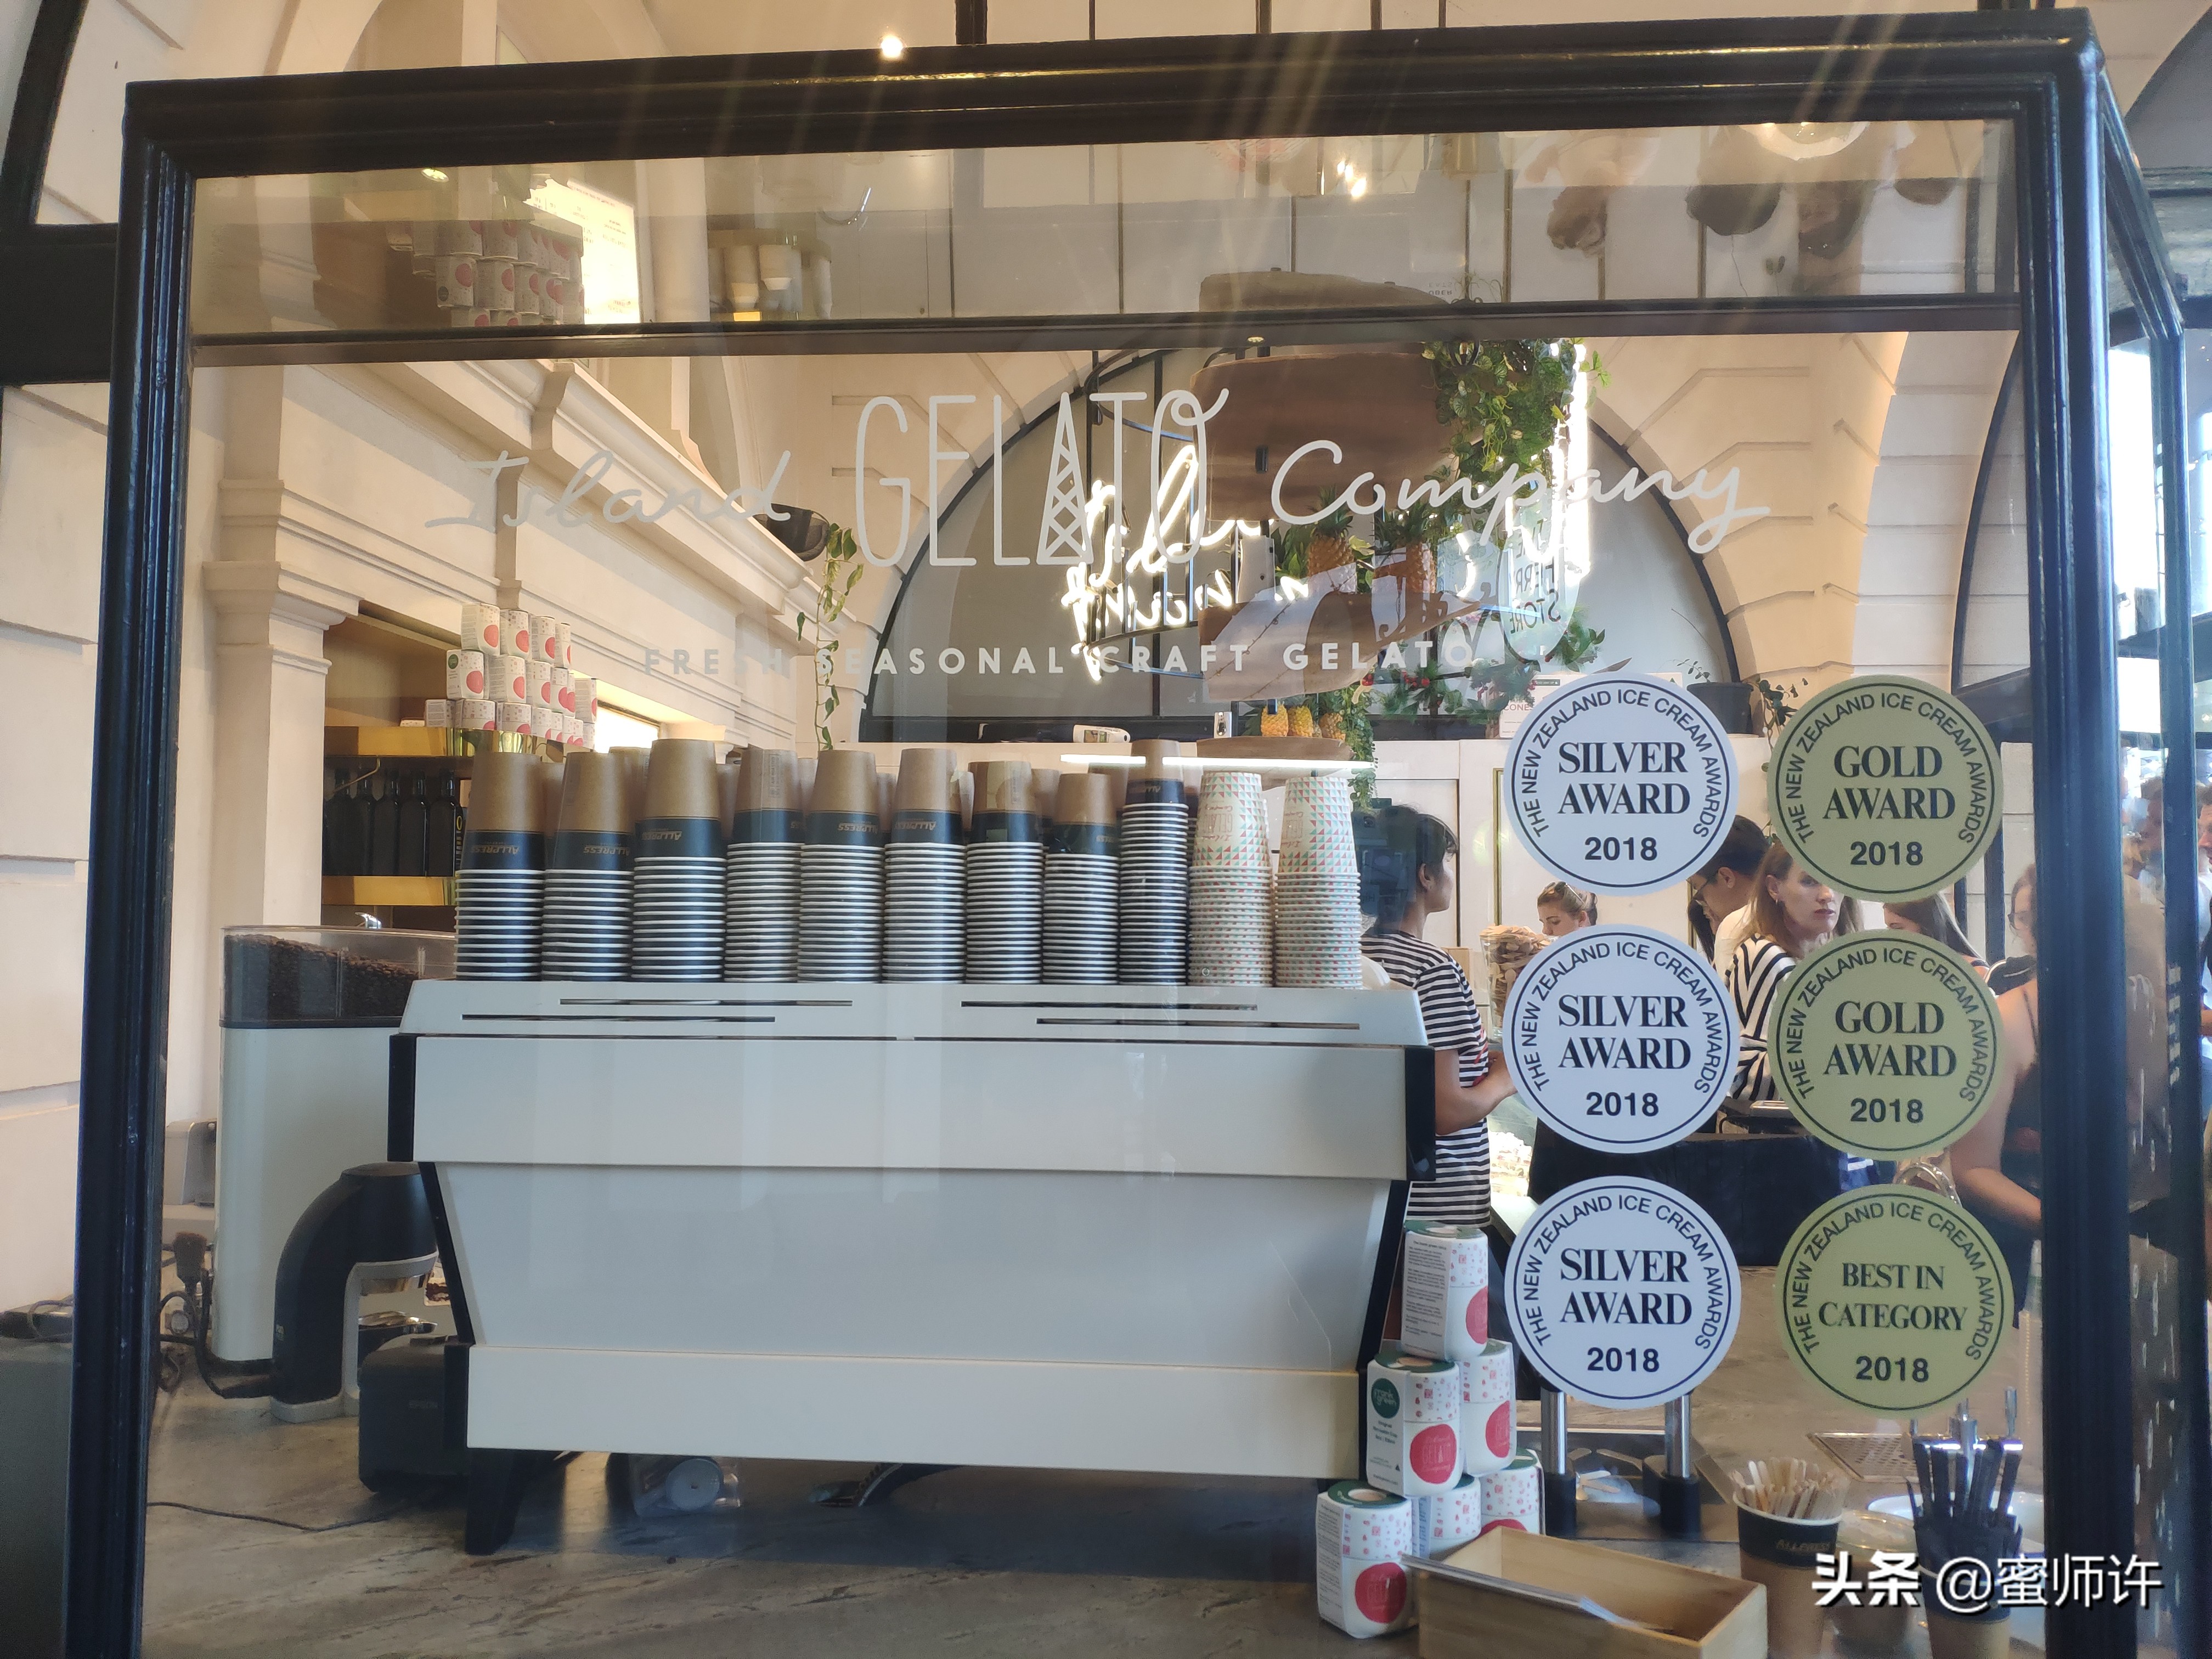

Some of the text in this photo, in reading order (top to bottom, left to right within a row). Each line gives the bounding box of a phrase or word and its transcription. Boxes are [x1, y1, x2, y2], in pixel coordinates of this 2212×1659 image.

[424, 449, 792, 533] Island
[856, 388, 1229, 566] GELATO
[1272, 440, 1770, 554] Company
[644, 640, 1473, 675] FRESH SEASONAL CRAFT GELATO
[1521, 689, 1722, 837] THE NEW ZEALAND ICE CREAM AWARDS
[1559, 742, 1688, 773] SILVER
[1786, 693, 1987, 843] THE NEW ZEALAND ICE CREAM AWARDS
[1834, 746, 1942, 777] GOLD
[1557, 783, 1690, 814] AWARD
[1822, 788, 1955, 819] AWARD
[642, 831, 682, 840] ALLPRES
[1585, 837, 1657, 861] 2018
[1850, 841, 1923, 866] 2018
[1521, 942, 1723, 1093] THE NEW ZEALAND ICE CREAM AWARDS
[1559, 995, 1689, 1027] SILVER
[1786, 948, 1988, 1101] THE NEW ZEALAND ICE CREAM AWARDS
[1835, 1001, 1944, 1034] GOLD
[1558, 1037, 1691, 1069] AWARD
[1823, 1043, 1956, 1076] AWARD
[1586, 1092, 1658, 1116] 2018
[1851, 1098, 1923, 1124] 2018
[1523, 1195, 1723, 1349] THE NEW ZEALAND ICE CREAM AWARDS
[1561, 1248, 1690, 1282] SILVER
[1792, 1202, 1995, 1359] THE NEW ZEALAND ICE CREAM AWARDS
[1842, 1263, 1944, 1289] BEST IN
[1560, 1291, 1692, 1325] AWARD
[1819, 1302, 1967, 1330] CATEGORY
[1588, 1347, 1660, 1373] 2018
[1856, 1356, 1929, 1383] 2018
